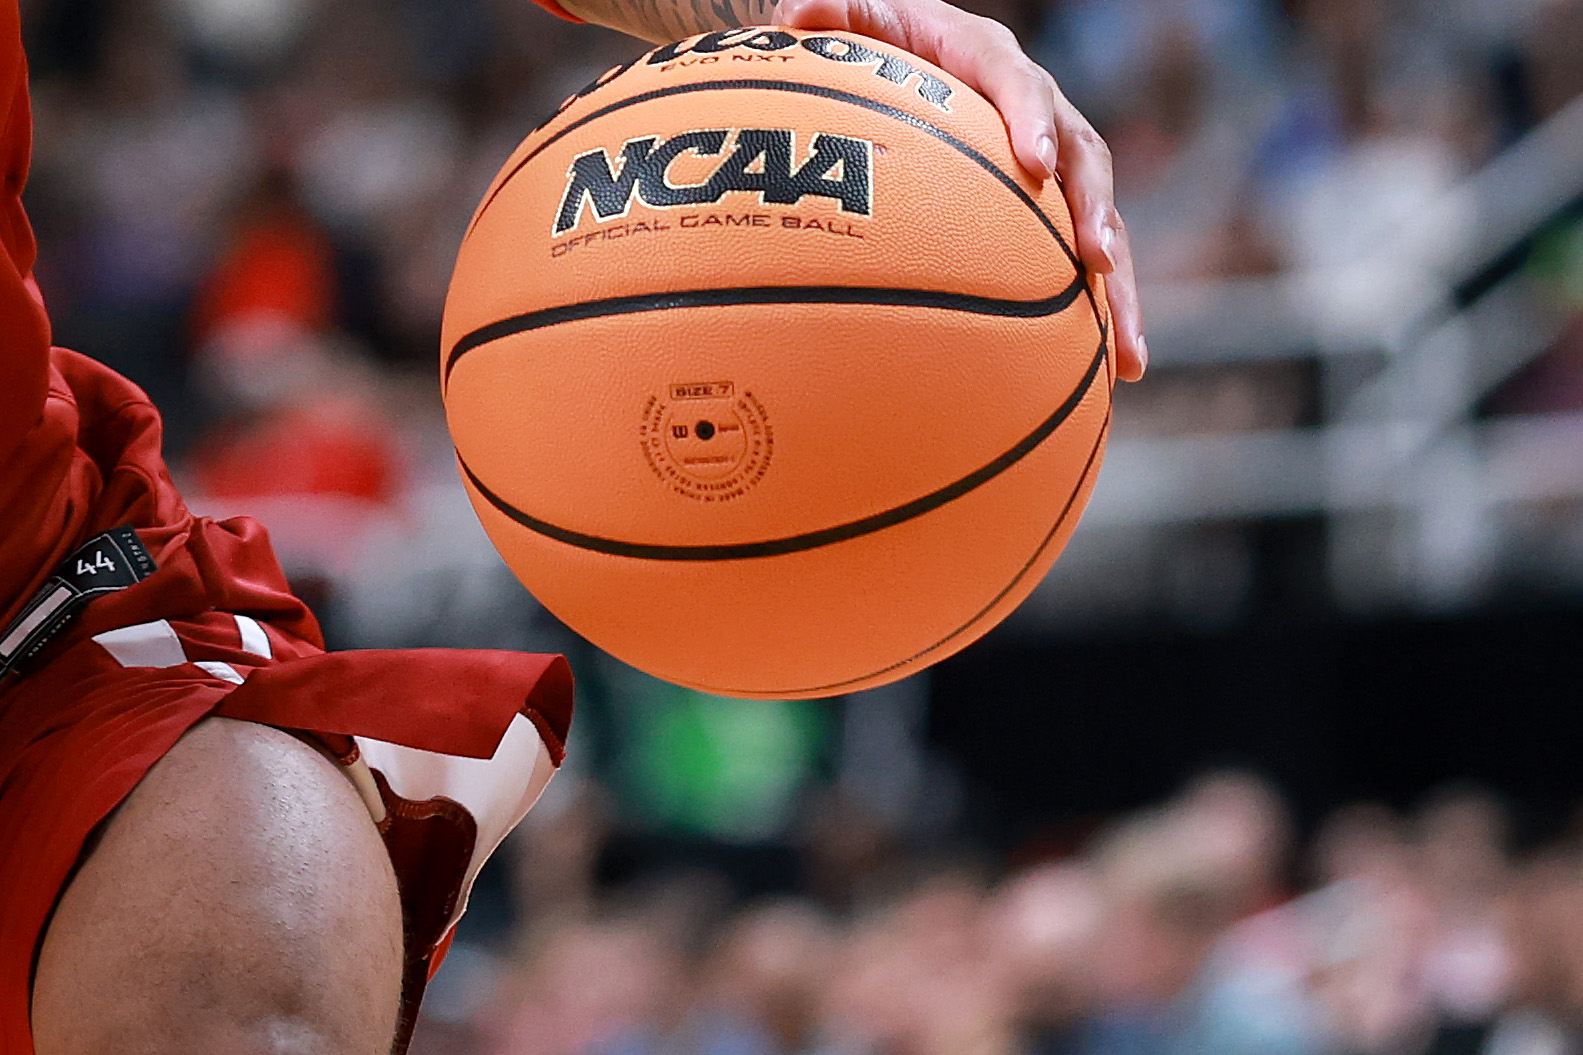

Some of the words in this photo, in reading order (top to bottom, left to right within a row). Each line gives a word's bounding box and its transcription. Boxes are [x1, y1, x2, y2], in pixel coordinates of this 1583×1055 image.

[659, 55, 720, 73] EVO
[731, 54, 795, 63] NXT
[550, 126, 875, 238] NCAA
[550, 218, 671, 259] OFFICIAL
[679, 213, 771, 229] GAME
[781, 215, 865, 240] BALL
[676, 385, 713, 397] SIZE
[76, 550, 116, 576] 44
